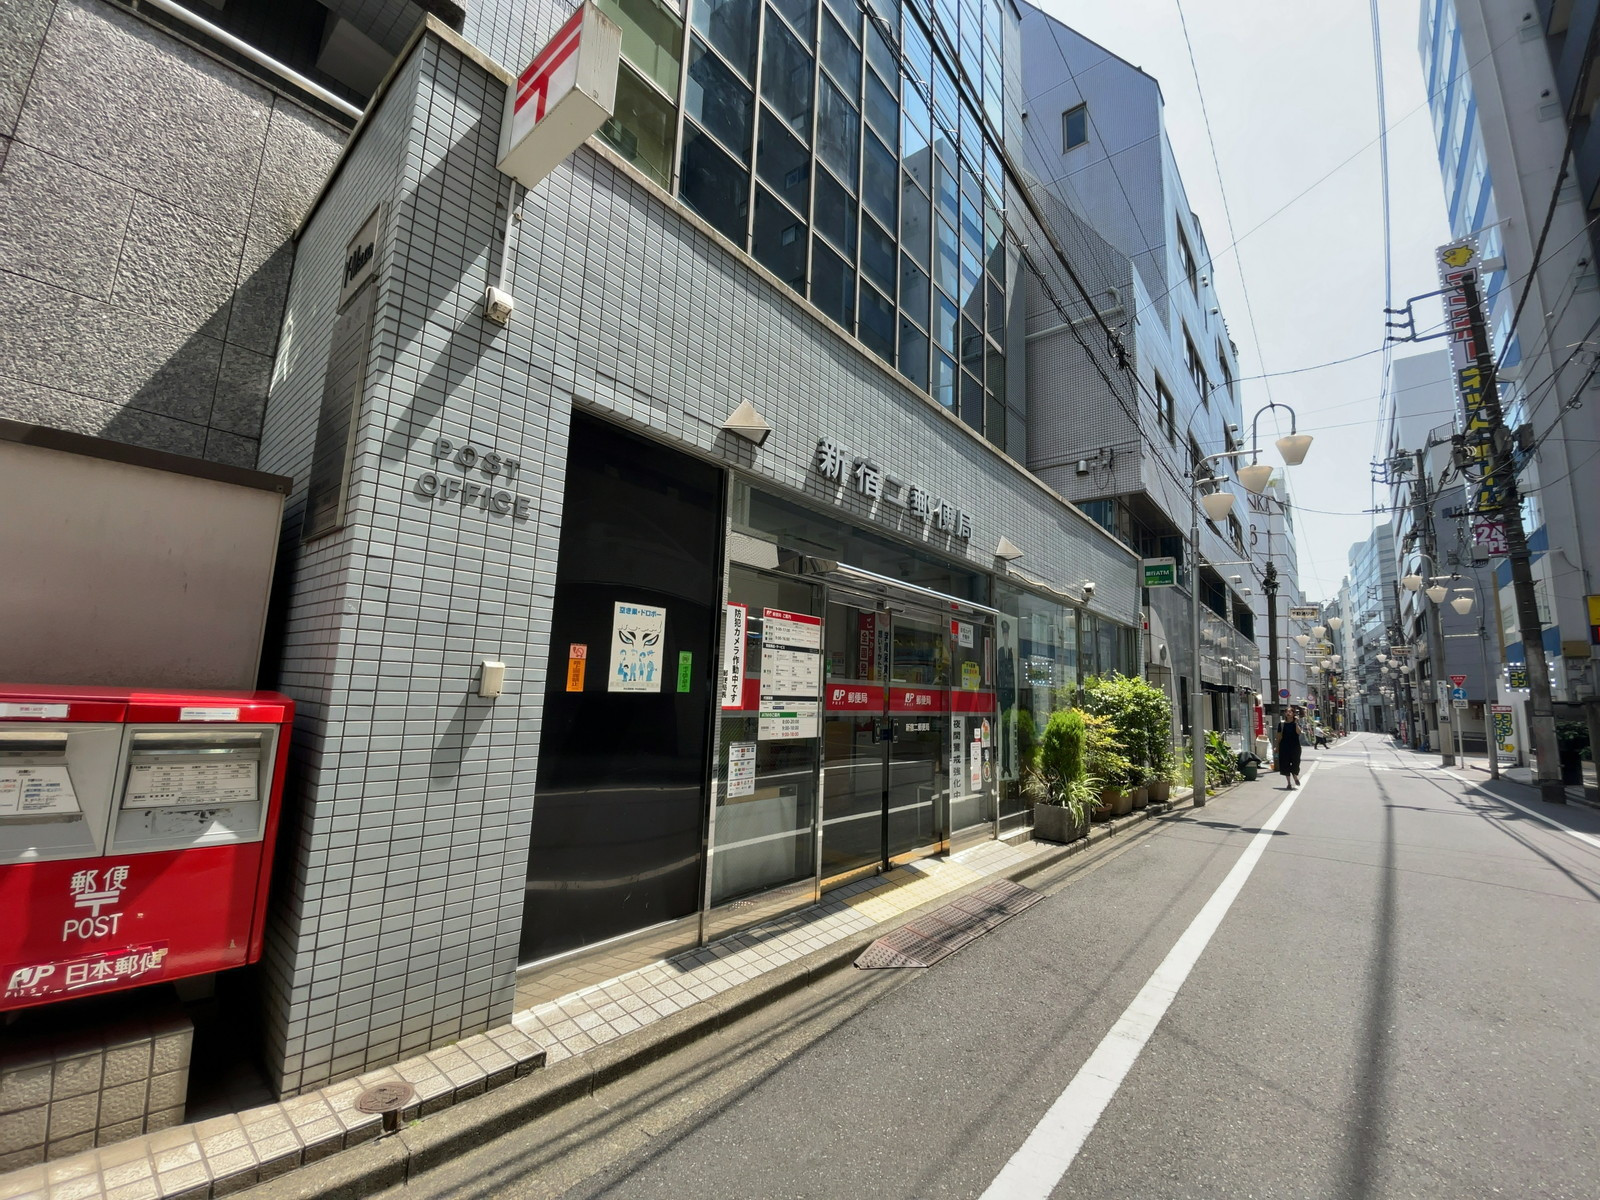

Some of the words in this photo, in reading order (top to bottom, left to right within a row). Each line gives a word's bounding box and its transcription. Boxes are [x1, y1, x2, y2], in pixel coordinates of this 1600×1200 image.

[434, 436, 521, 480] POST
[417, 472, 531, 519] OFFICE
[818, 436, 972, 539] 新宿二郵便局
[731, 608, 742, 703] 防犯カメラ作動中です
[848, 692, 868, 704] 郵便局
[916, 695, 932, 706] 郵便局
[1503, 713, 1513, 736] コイン
[952, 719, 962, 799] 夜間警戒強化中
[70, 865, 130, 896] 郵便
[62, 912, 124, 942] POST
[66, 951, 163, 985] 日本郵便
